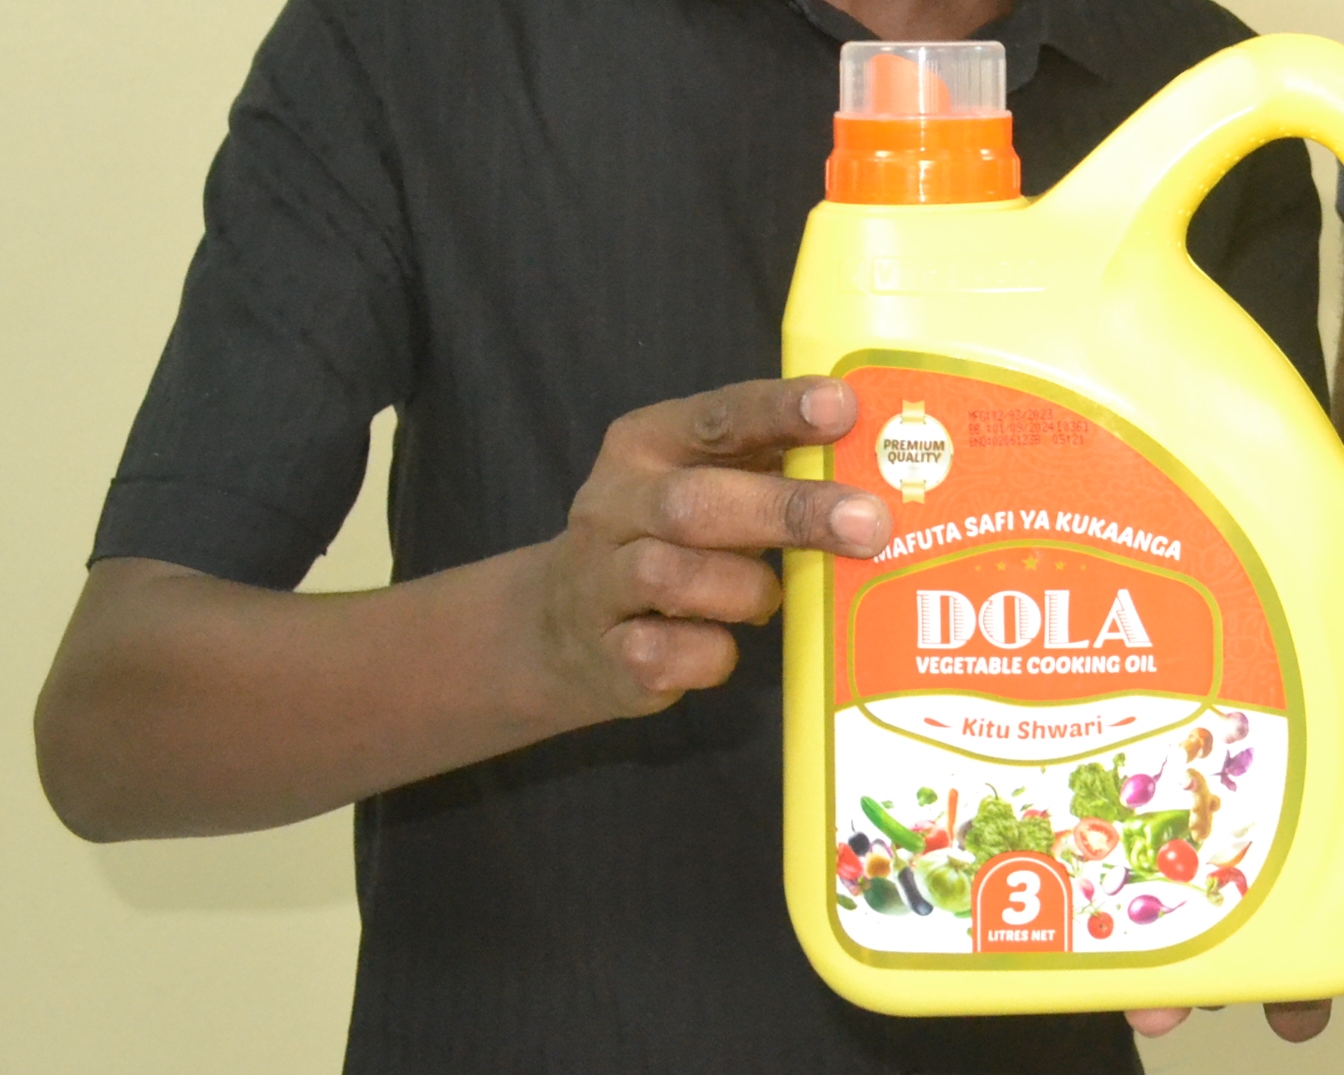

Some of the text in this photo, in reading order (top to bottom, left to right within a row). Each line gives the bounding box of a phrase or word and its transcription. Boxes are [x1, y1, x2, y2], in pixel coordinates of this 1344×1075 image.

[883, 439, 946, 451] PREMIUM
[887, 451, 942, 464] QUALITY
[964, 510, 1015, 538] SAFI
[1019, 509, 1051, 531] YA
[1055, 511, 1182, 561] KUKAANGA
[916, 588, 1153, 650] DOLA
[915, 654, 1158, 676] VEGETABLE COOKING OIL
[961, 715, 1103, 740] Kitu Shwari
[1001, 869, 1042, 926] 3
[987, 929, 1056, 942] LITRES NET
